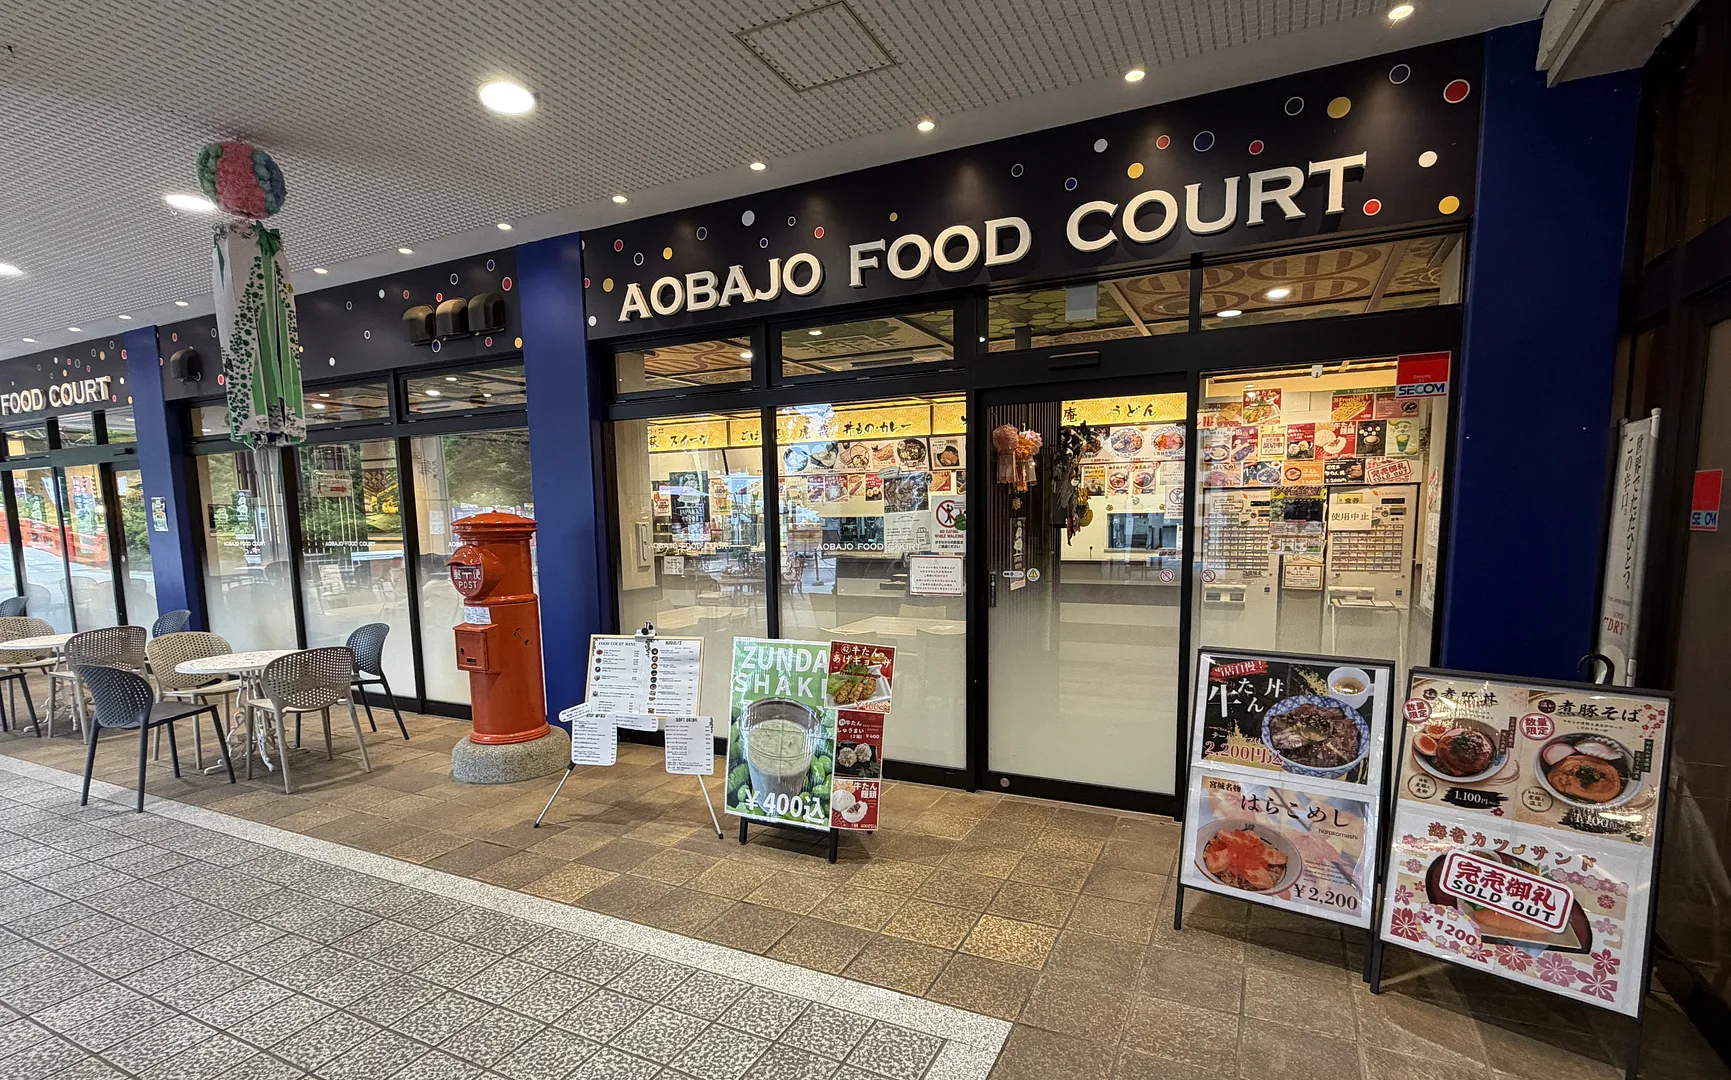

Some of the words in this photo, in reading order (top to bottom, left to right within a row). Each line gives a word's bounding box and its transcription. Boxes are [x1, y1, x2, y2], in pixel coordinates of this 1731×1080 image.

[618, 252, 824, 322] AOBAJO
[849, 216, 1032, 288] FOOD
[1066, 151, 1366, 252] COURT
[0, 388, 44, 416] FOOD
[49, 375, 111, 407] COURT
[1398, 383, 1445, 396] SECOM
[1112, 404, 1156, 417] うどん
[842, 420, 912, 436] 丼もの・カレー
[670, 434, 709, 447] スイーツ
[1331, 512, 1370, 521] 使用中止
[816, 543, 854, 551] AOBAJO
[857, 543, 884, 551] FOOD
[458, 581, 477, 589] POST
[851, 645, 880, 658] 牛たん
[741, 646, 828, 674] ZUNDA
[832, 654, 892, 669] あげギョーザ
[1406, 701, 1425, 711] 数量
[1557, 700, 1643, 723] 煮豚そば
[1408, 709, 1428, 719] 限定
[1525, 717, 1549, 727] 数量
[1526, 726, 1549, 736] 限定
[1204, 740, 1283, 766] 2,200円込
[853, 781, 878, 791] 牛たん
[1209, 780, 1242, 793] 宮城名物
[1241, 794, 1350, 828] はらこめし
[1454, 860, 1557, 912] 完売御礼
[1451, 879, 1502, 904] SOLD
[1512, 900, 1556, 923] OUT
